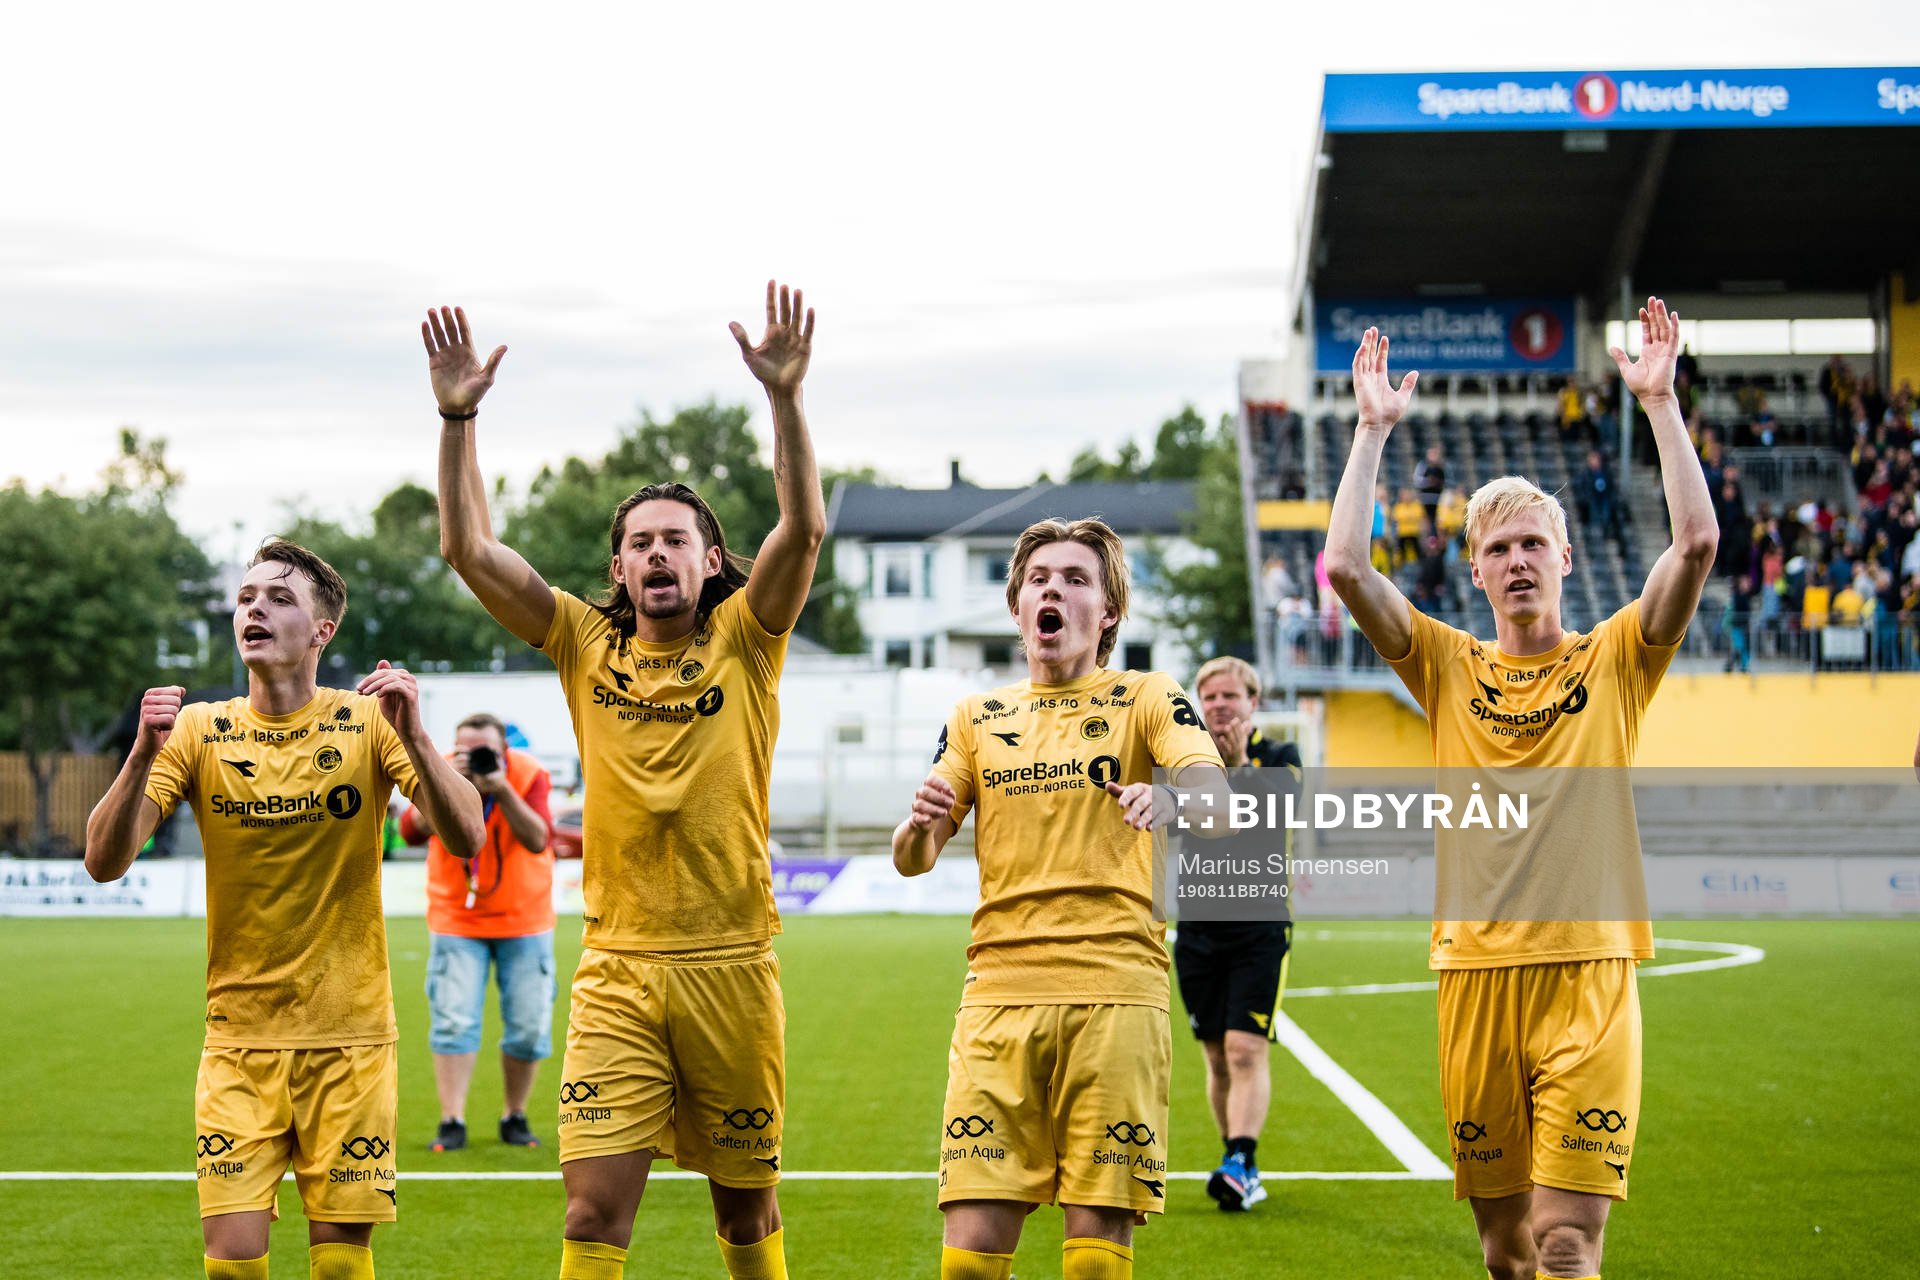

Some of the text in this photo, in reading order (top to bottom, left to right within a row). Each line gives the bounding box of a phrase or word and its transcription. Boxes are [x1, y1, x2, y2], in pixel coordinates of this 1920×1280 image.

[1418, 82, 1571, 120] SpareBank
[1620, 80, 1789, 117] Nord-Norge
[1030, 697, 1078, 712] laks.no
[618, 711, 695, 724] NORD-NORGE
[254, 728, 309, 742] laks.no
[338, 722, 365, 734] Energi
[982, 758, 1084, 789] SpareBank
[1005, 779, 1085, 797] NORD-NORGE
[211, 790, 322, 817] SpareBank
[240, 811, 325, 828] NORD-NORGE
[575, 1108, 611, 1124] Aqua
[712, 1132, 779, 1151] Salten Aqua
[1561, 1134, 1630, 1157] Salten Aqua
[971, 1144, 1005, 1162] Aqua
[1093, 1149, 1166, 1173] Salten Aqua
[1469, 1147, 1503, 1164] Aqua
[209, 1162, 243, 1178] Aqua
[329, 1168, 371, 1183] Salten
